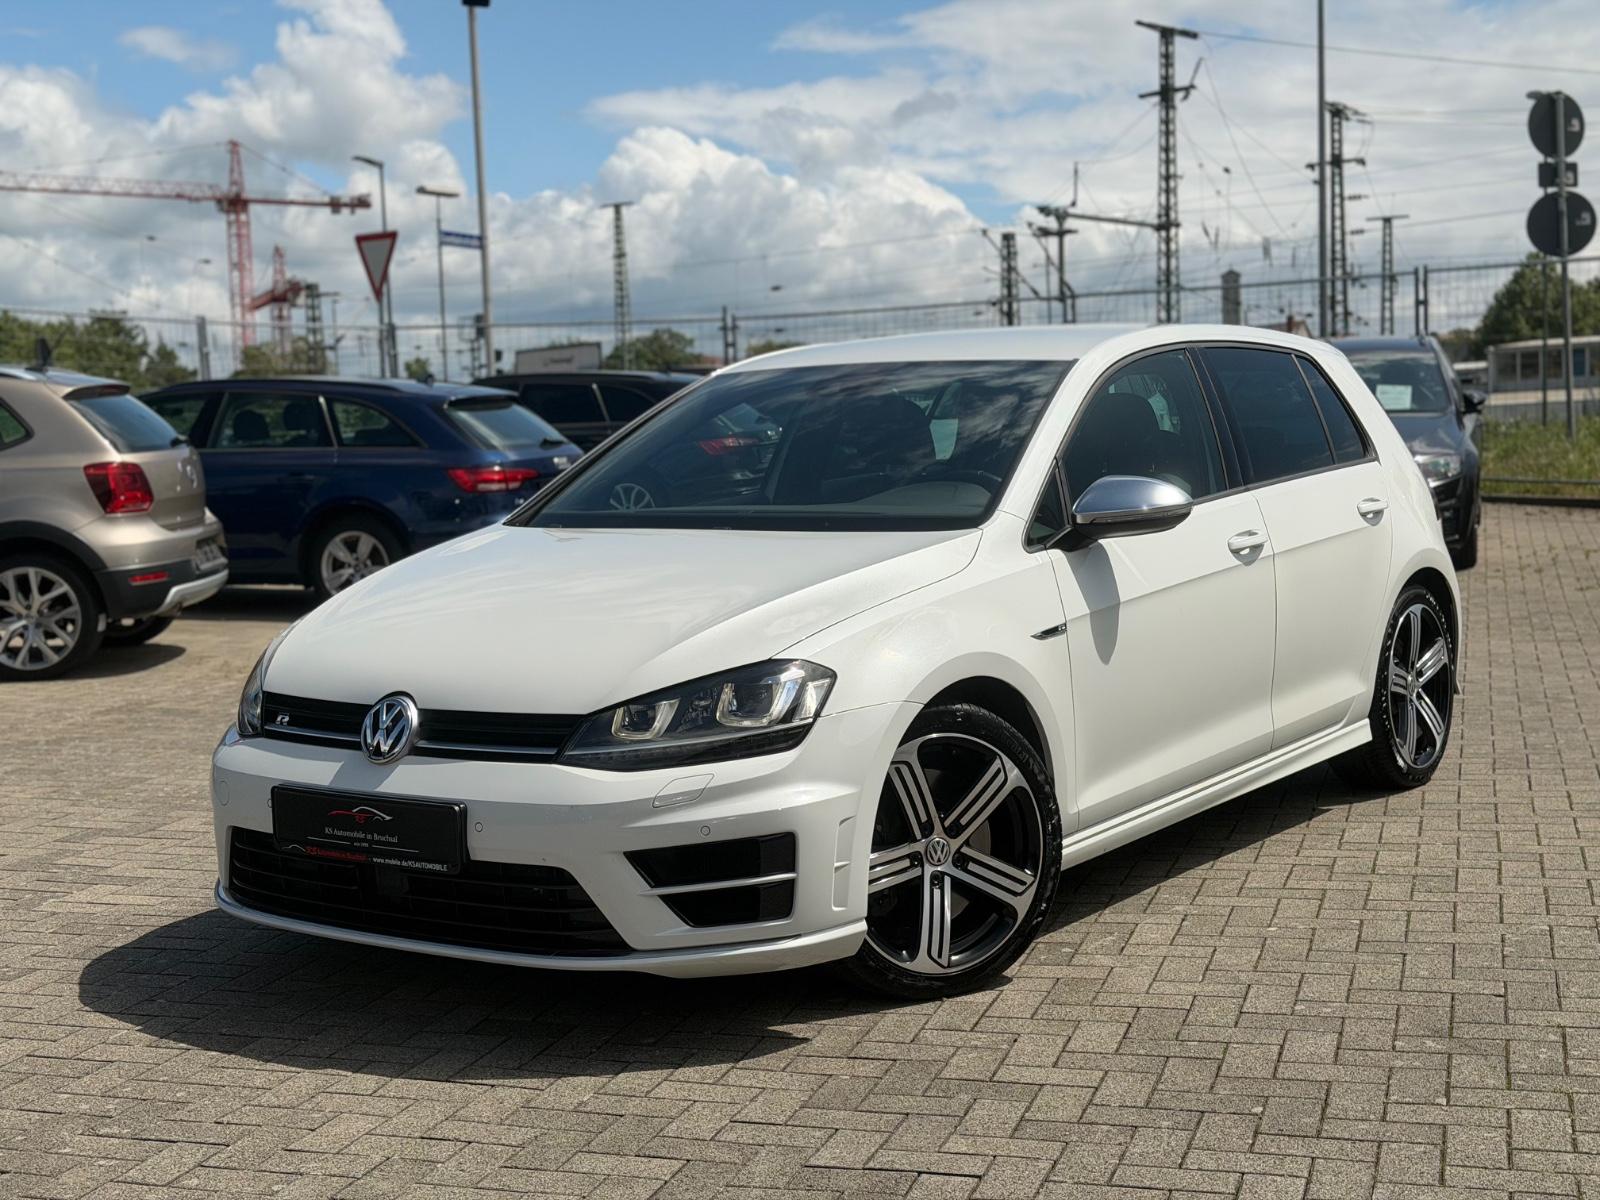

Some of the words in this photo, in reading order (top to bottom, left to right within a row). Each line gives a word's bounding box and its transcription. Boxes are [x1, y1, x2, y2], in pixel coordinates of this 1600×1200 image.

[276, 713, 289, 725] R
[325, 826, 333, 834] KS
[334, 828, 365, 838] Automobile
